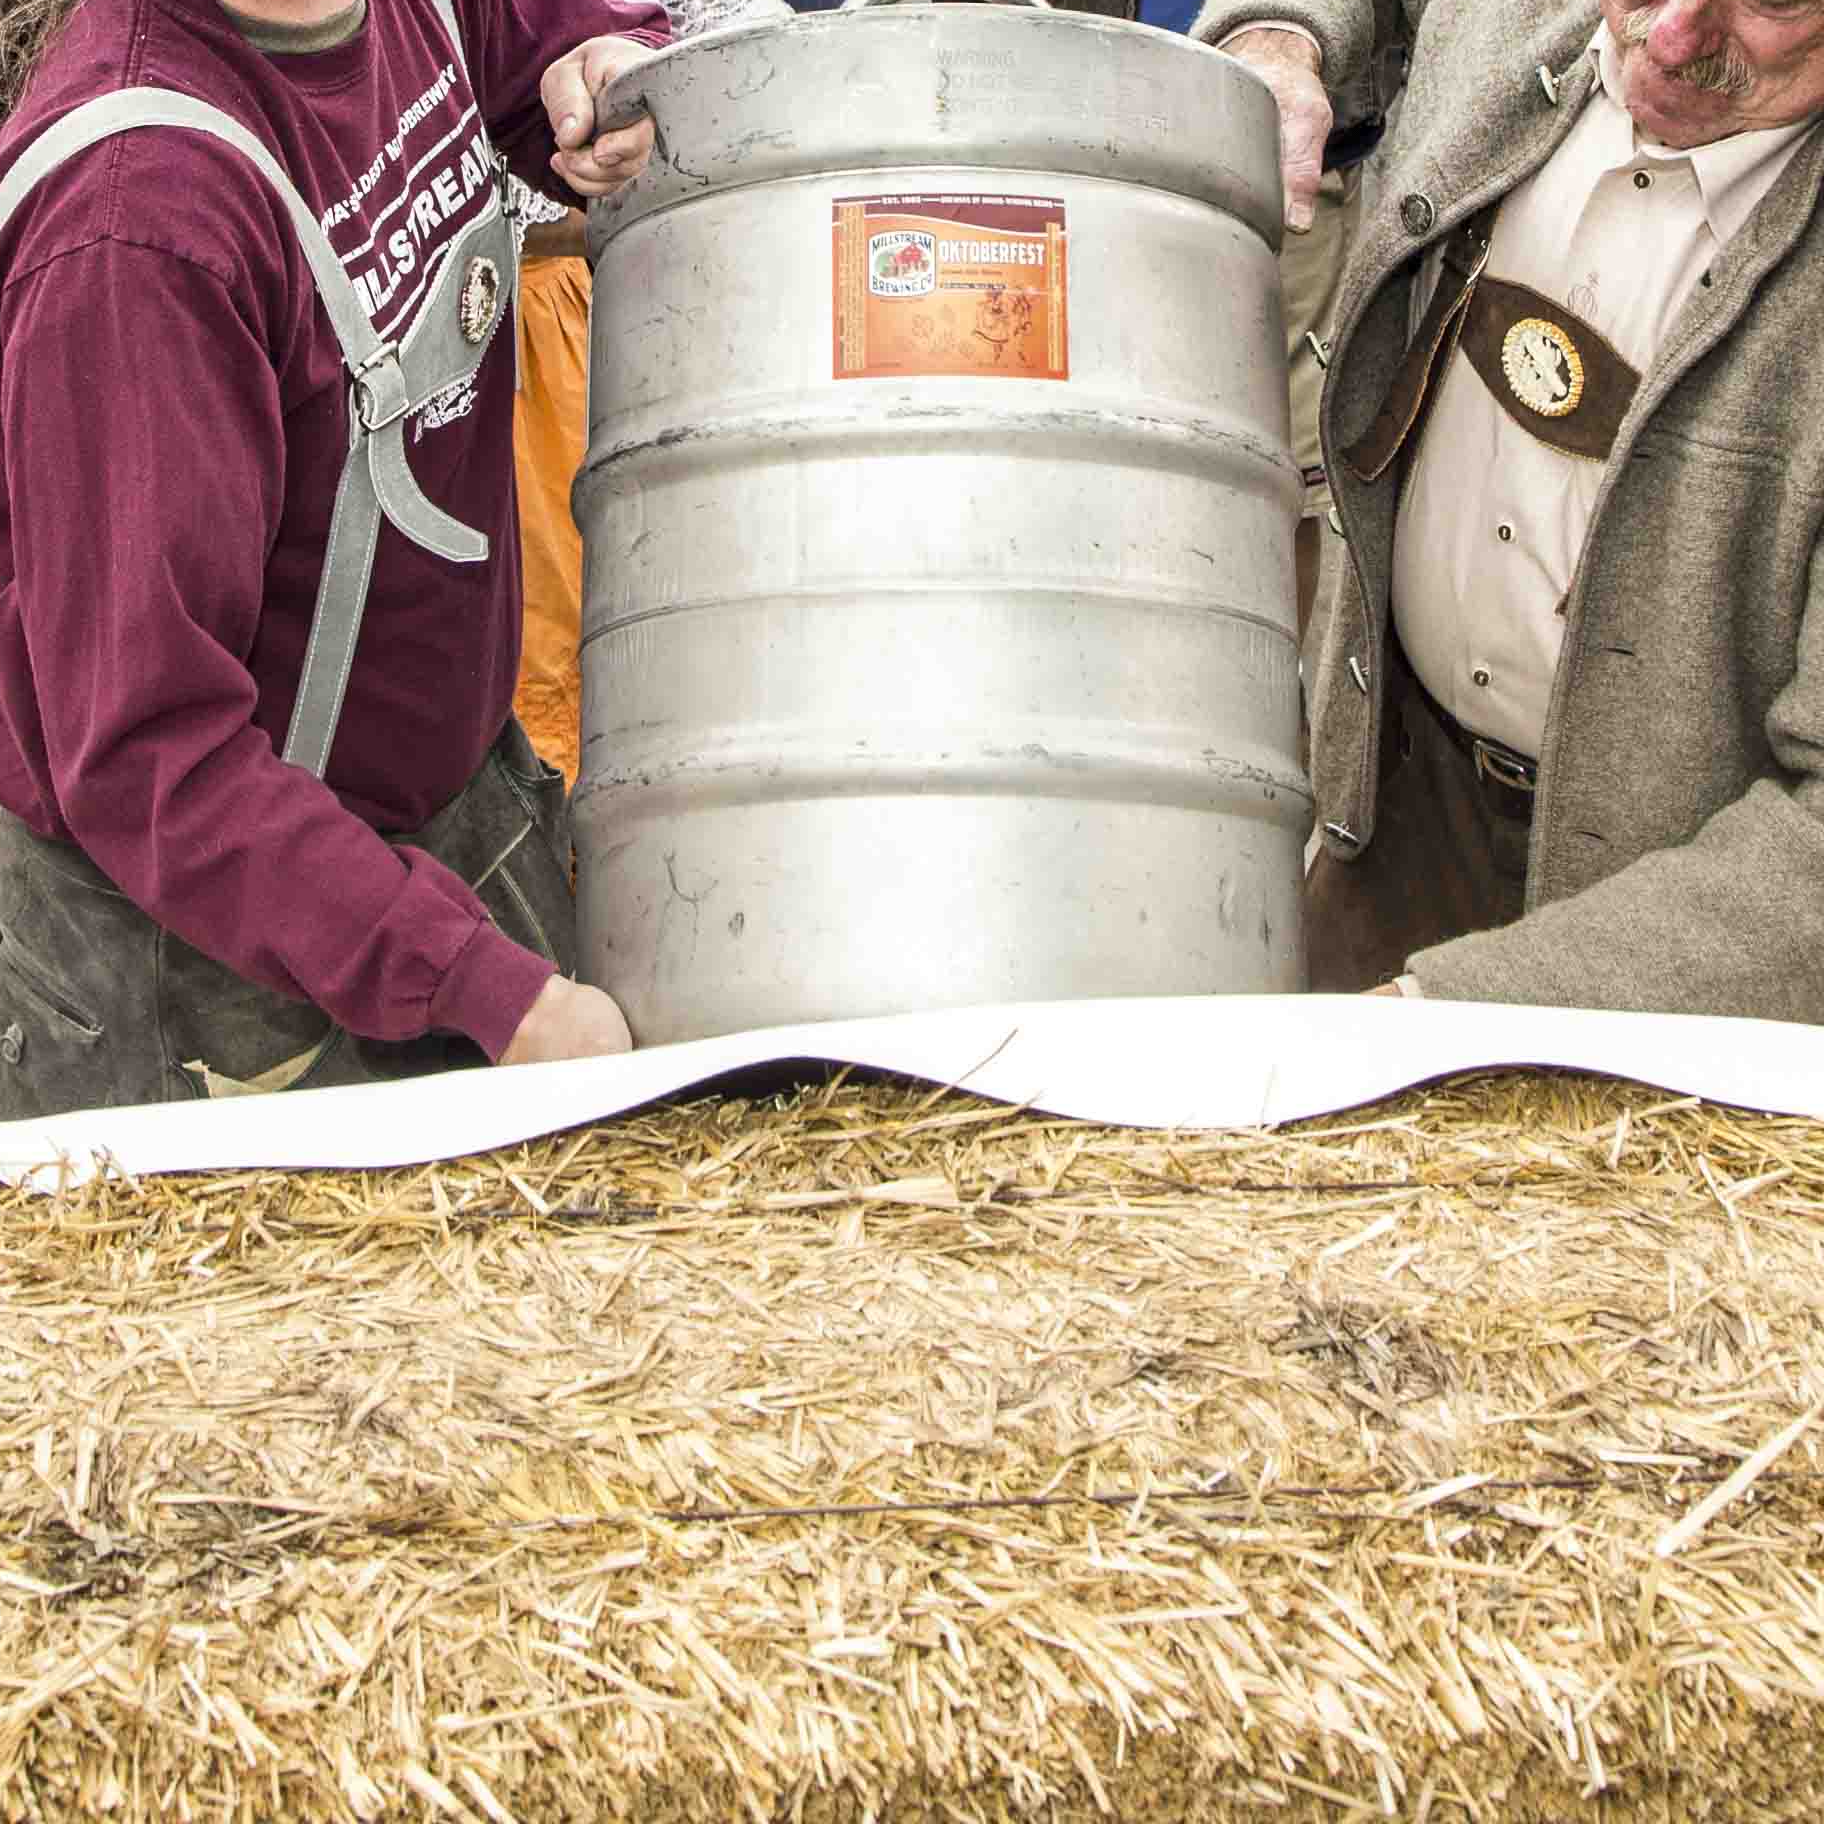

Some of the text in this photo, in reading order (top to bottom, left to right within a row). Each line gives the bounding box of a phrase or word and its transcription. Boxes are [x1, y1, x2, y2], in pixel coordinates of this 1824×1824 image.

[872, 233, 932, 252] MILLSTREAM
[939, 240, 1045, 265] OKTOBERFEST
[872, 274, 918, 293] BREWING
